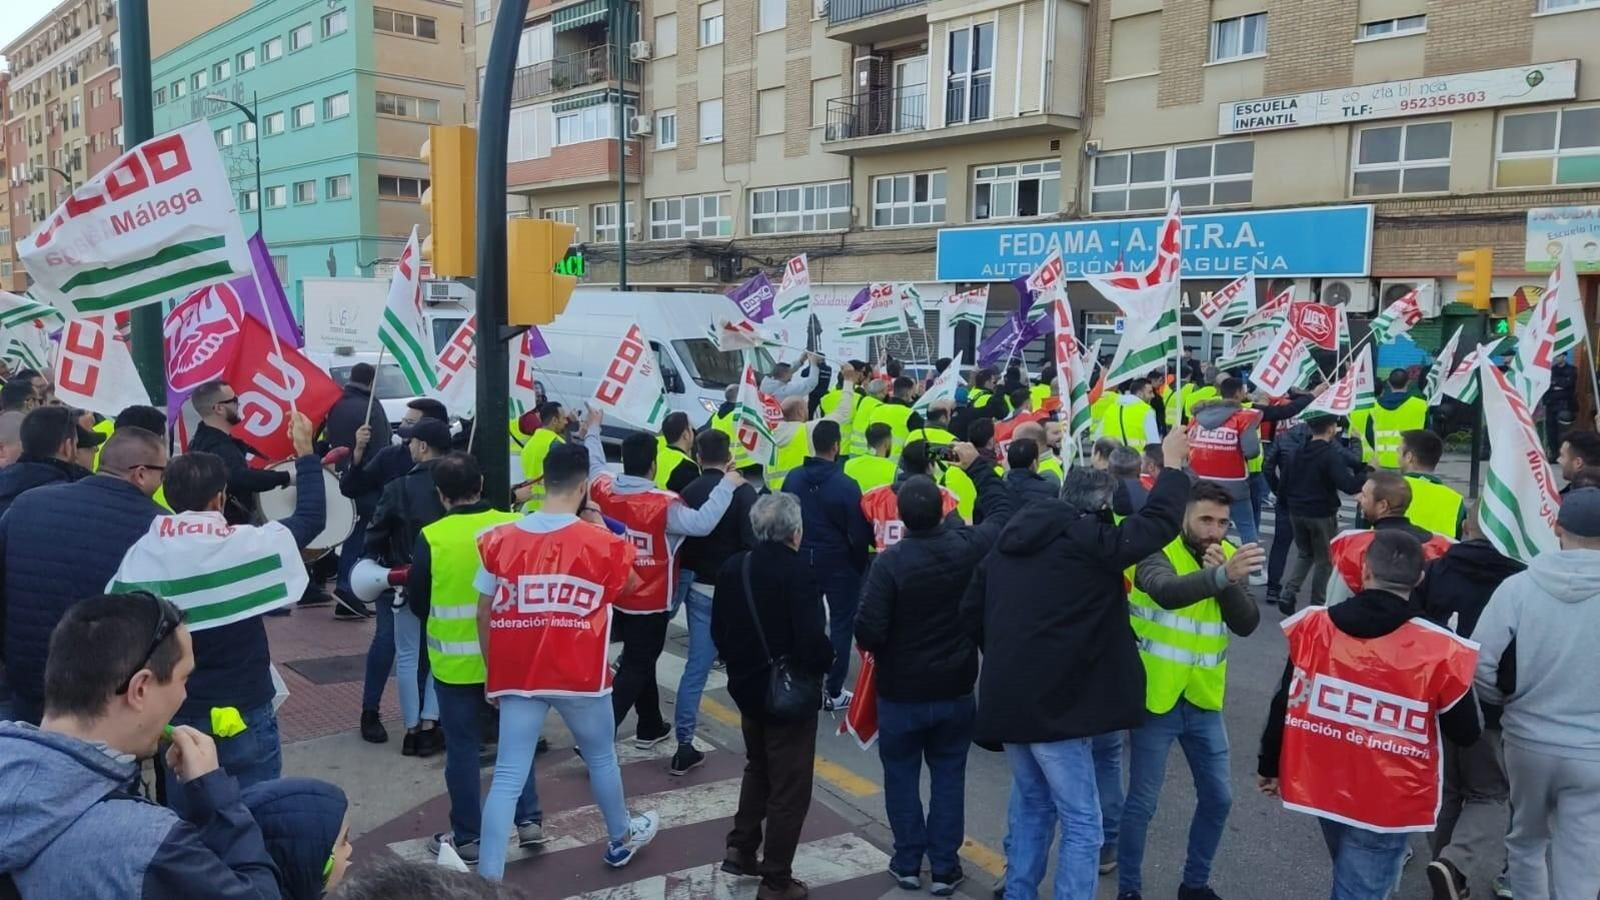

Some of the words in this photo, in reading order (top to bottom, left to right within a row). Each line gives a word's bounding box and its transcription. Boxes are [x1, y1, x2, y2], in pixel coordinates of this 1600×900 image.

[1236, 99, 1298, 115] ESCUELA
[1342, 105, 1373, 117] TLF:
[1400, 91, 1486, 110] 952356303
[1235, 113, 1297, 128] INFANTIL
[110, 187, 203, 236] Málaga
[1000, 229, 1104, 257] FEDAMA
[1547, 226, 1586, 240] Escuela
[524, 582, 597, 607] CCOO
[550, 616, 591, 630] industria
[1318, 683, 1429, 736] CCOO
[1346, 728, 1364, 745] de
